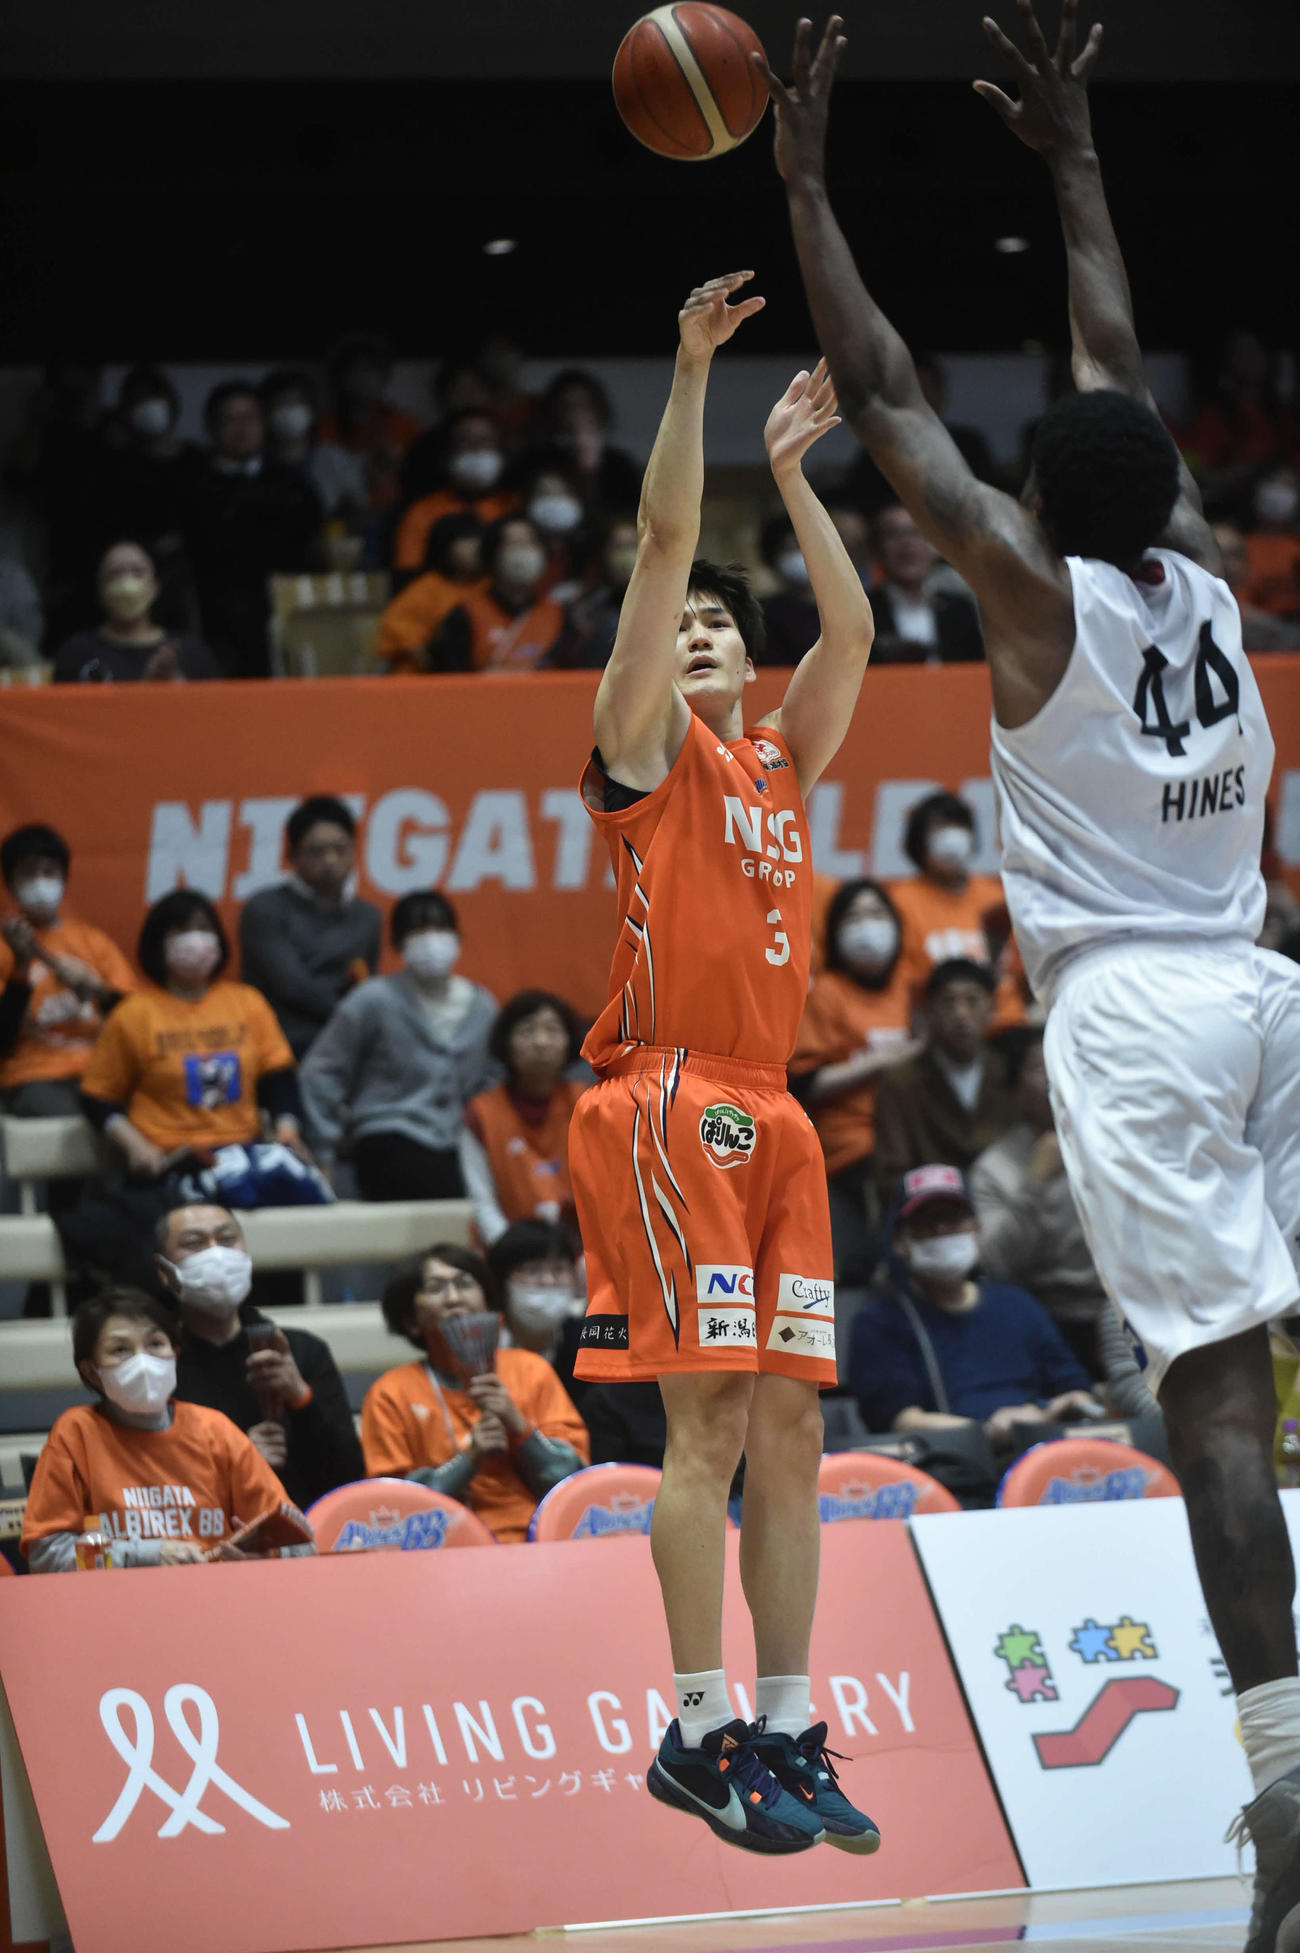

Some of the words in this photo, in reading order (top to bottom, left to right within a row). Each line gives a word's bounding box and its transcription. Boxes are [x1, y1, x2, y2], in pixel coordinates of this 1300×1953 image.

[1132, 620, 1243, 756] 44
[1162, 764, 1245, 822] HINES
[145, 787, 617, 902] NIGAT
[723, 795, 802, 862] NSG
[765, 908, 791, 966] 3
[701, 1116, 754, 1150] ぱりんこ
[707, 1273, 754, 1295] NC
[792, 1280, 830, 1308] Crafty
[122, 1485, 197, 1507] NIIGATA
[100, 1508, 193, 1540] ALBIREX
[295, 1696, 557, 1775] LIVING
[319, 1781, 445, 1812] 株式会社
[462, 1767, 644, 1802] リビングギャ
